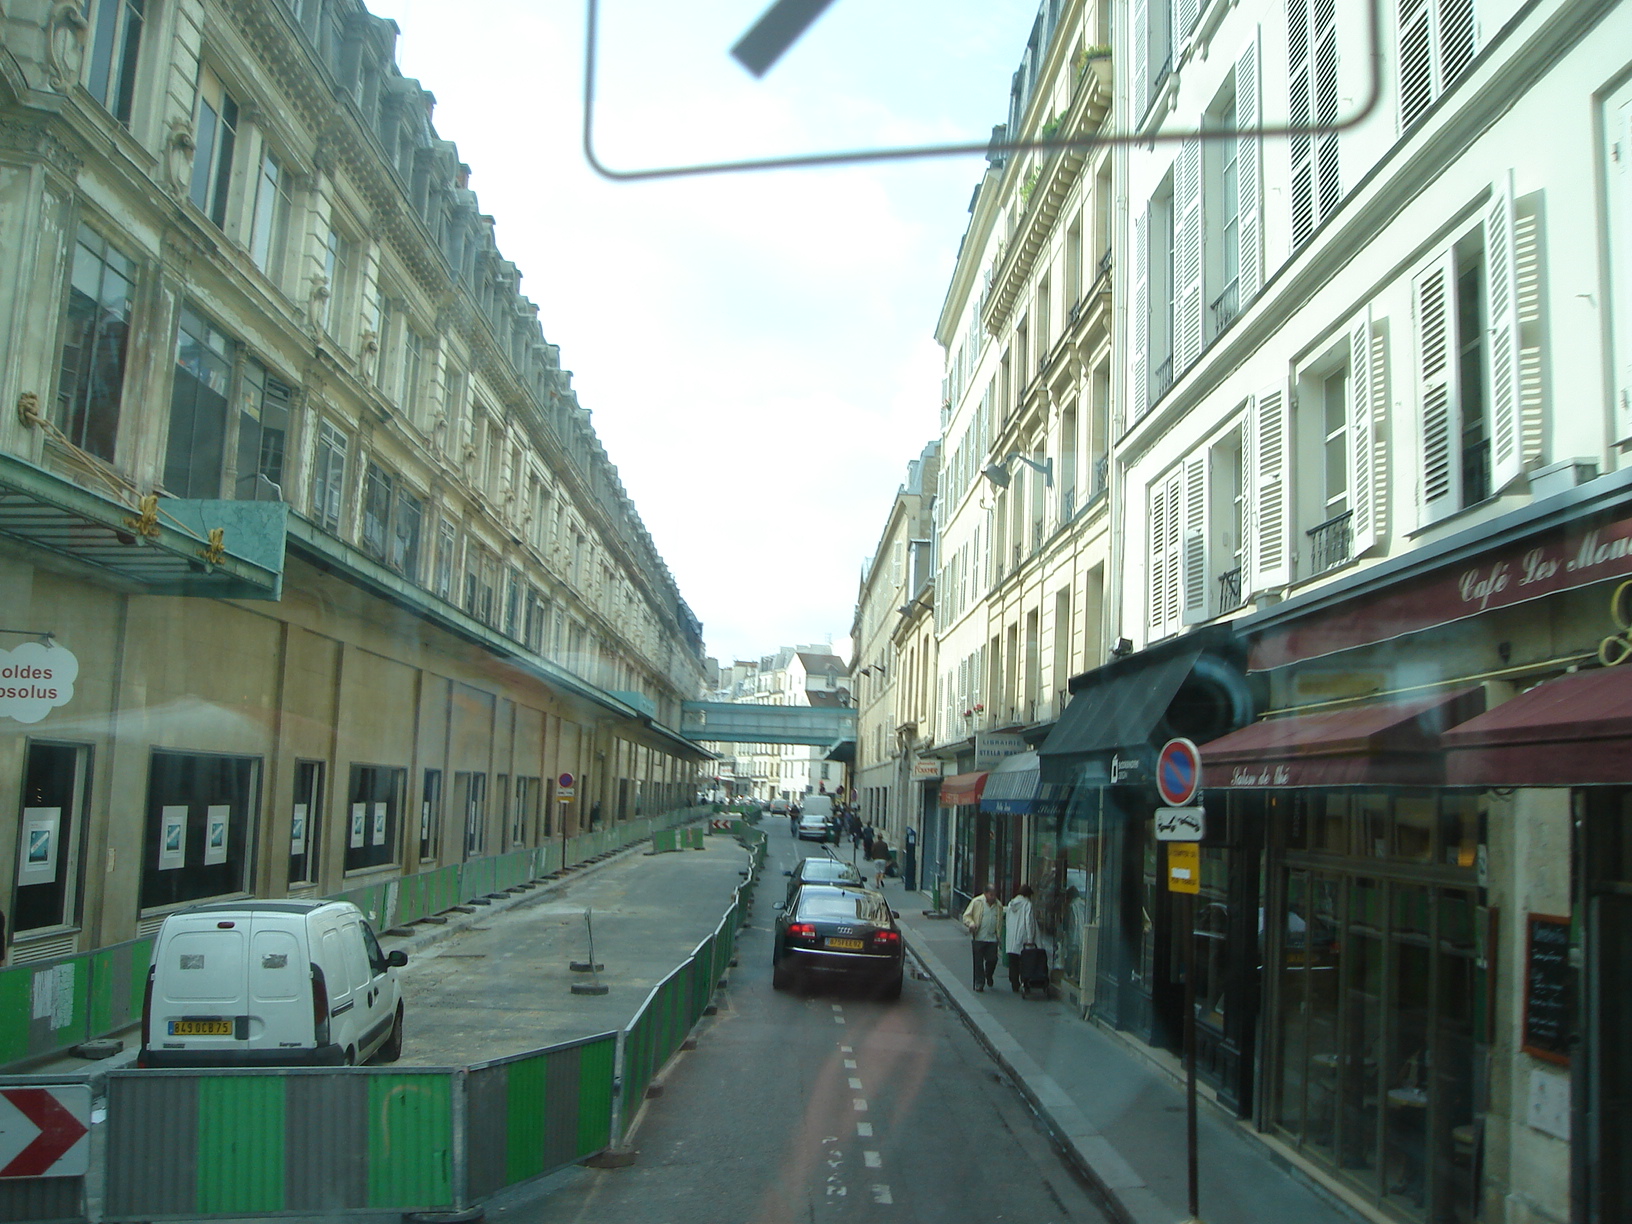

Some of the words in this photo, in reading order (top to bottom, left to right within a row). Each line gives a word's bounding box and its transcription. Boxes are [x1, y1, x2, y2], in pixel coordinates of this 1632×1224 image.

[1458, 561, 1511, 610] Café
[1518, 546, 1564, 586] Les
[1257, 765, 1270, 786] de
[174, 1022, 193, 1033] 849
[216, 1022, 229, 1033] 75
